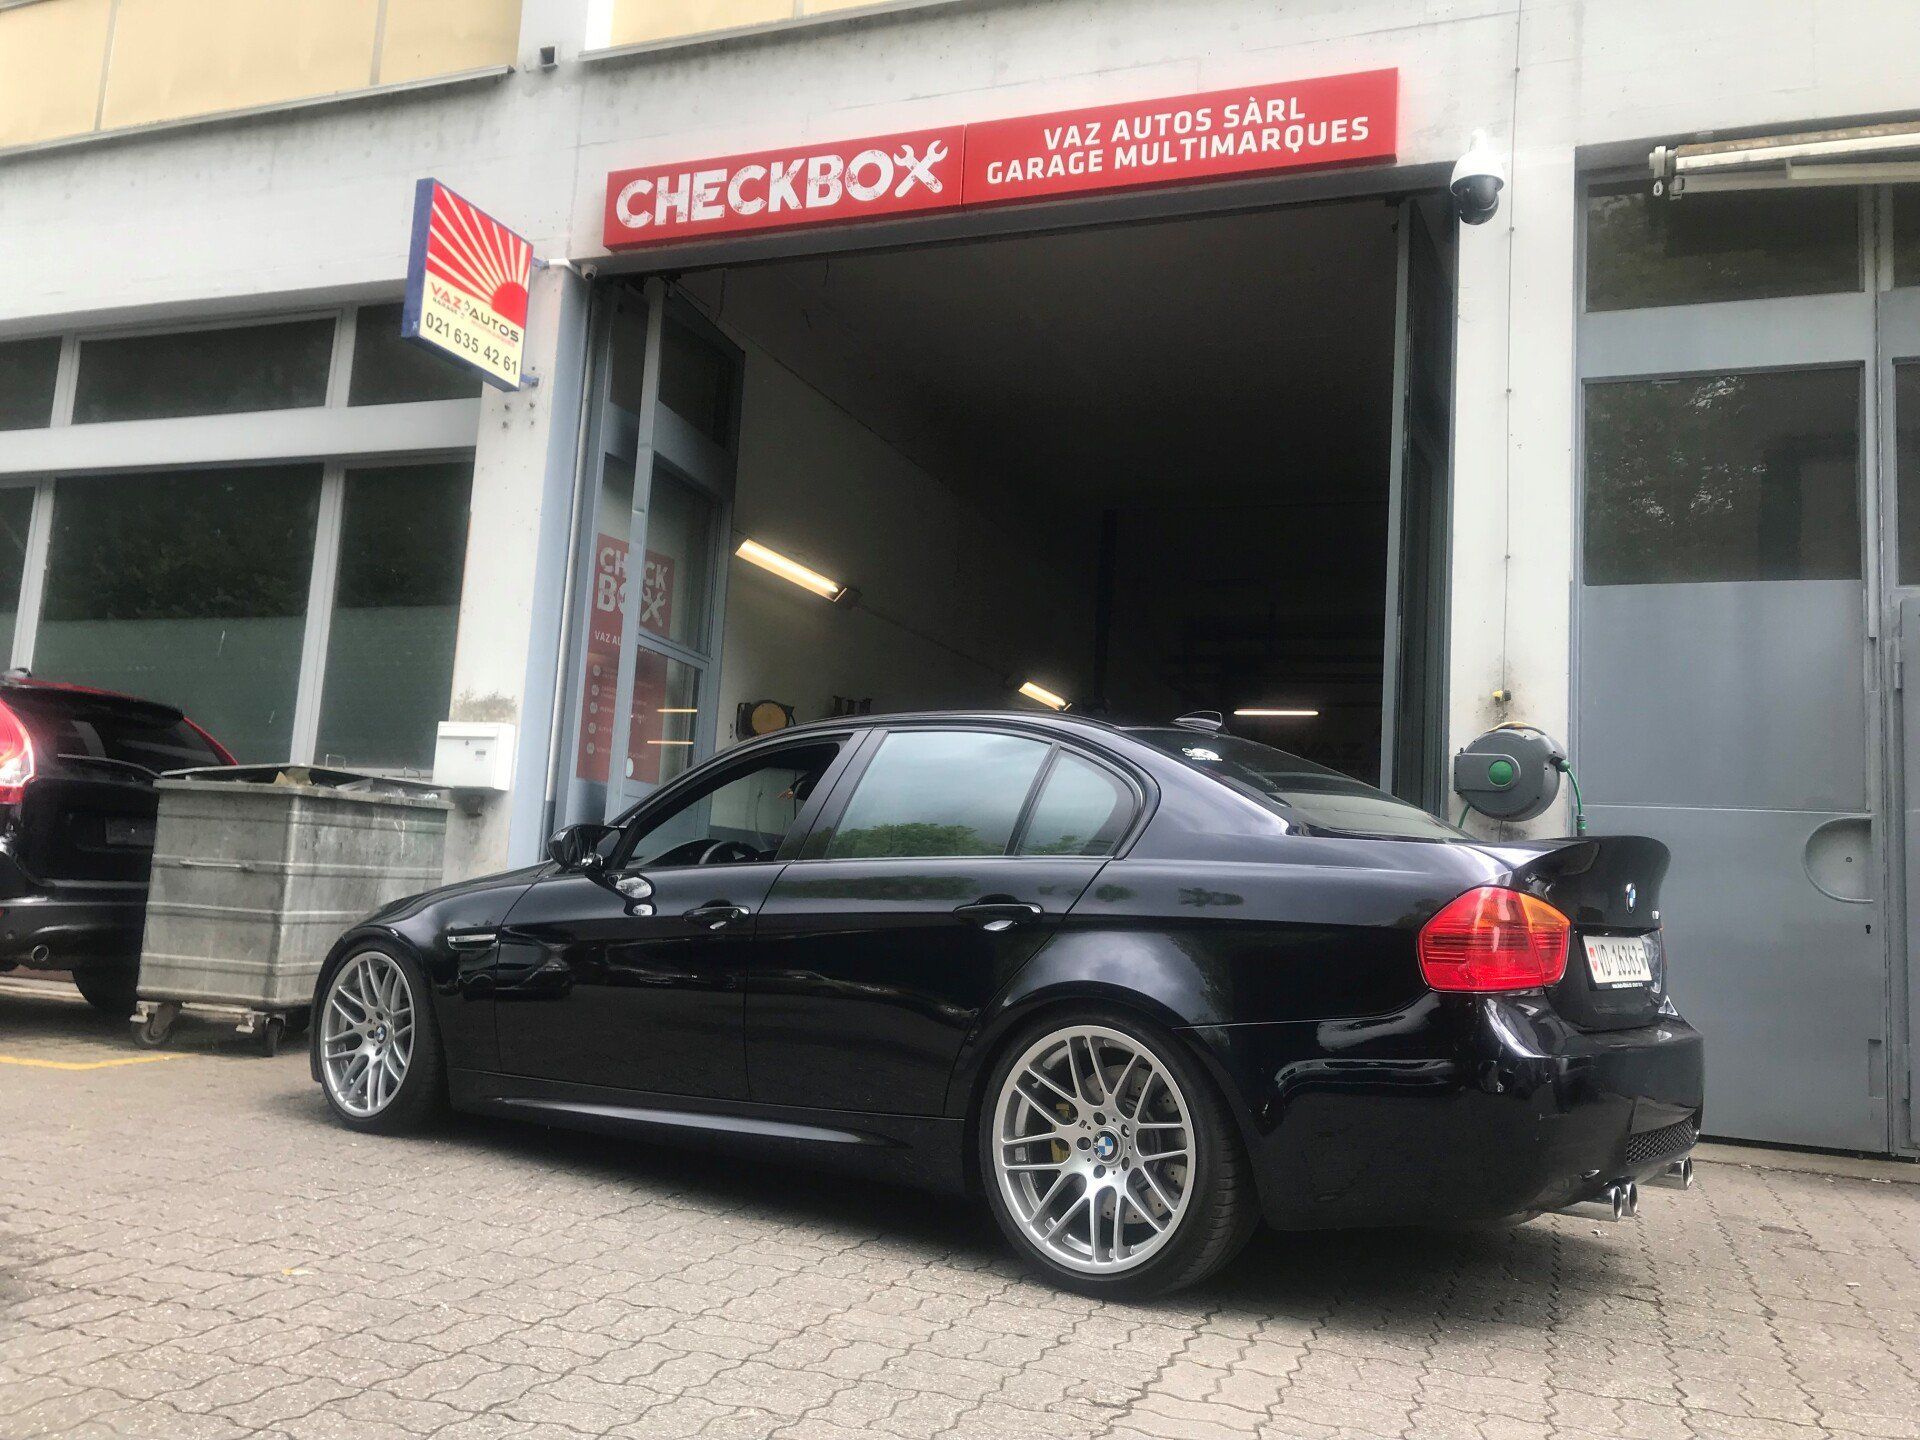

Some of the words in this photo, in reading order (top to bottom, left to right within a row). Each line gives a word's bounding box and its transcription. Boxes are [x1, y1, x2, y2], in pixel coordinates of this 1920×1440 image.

[986, 149, 1104, 185] GARAGE
[1114, 116, 1370, 170] MULTIMARQUES
[1043, 121, 1102, 151] VAZ
[1111, 107, 1213, 143] AUTOS
[1222, 95, 1307, 130] SÀRL
[615, 139, 949, 230] CHECKBOX
[431, 281, 462, 310] VAZ
[469, 307, 520, 343] AUTOS
[425, 312, 450, 338] 021
[454, 327, 479, 354] 635
[483, 345, 500, 367] 42
[503, 355, 517, 375] 61
[600, 547, 668, 591] CHCK
